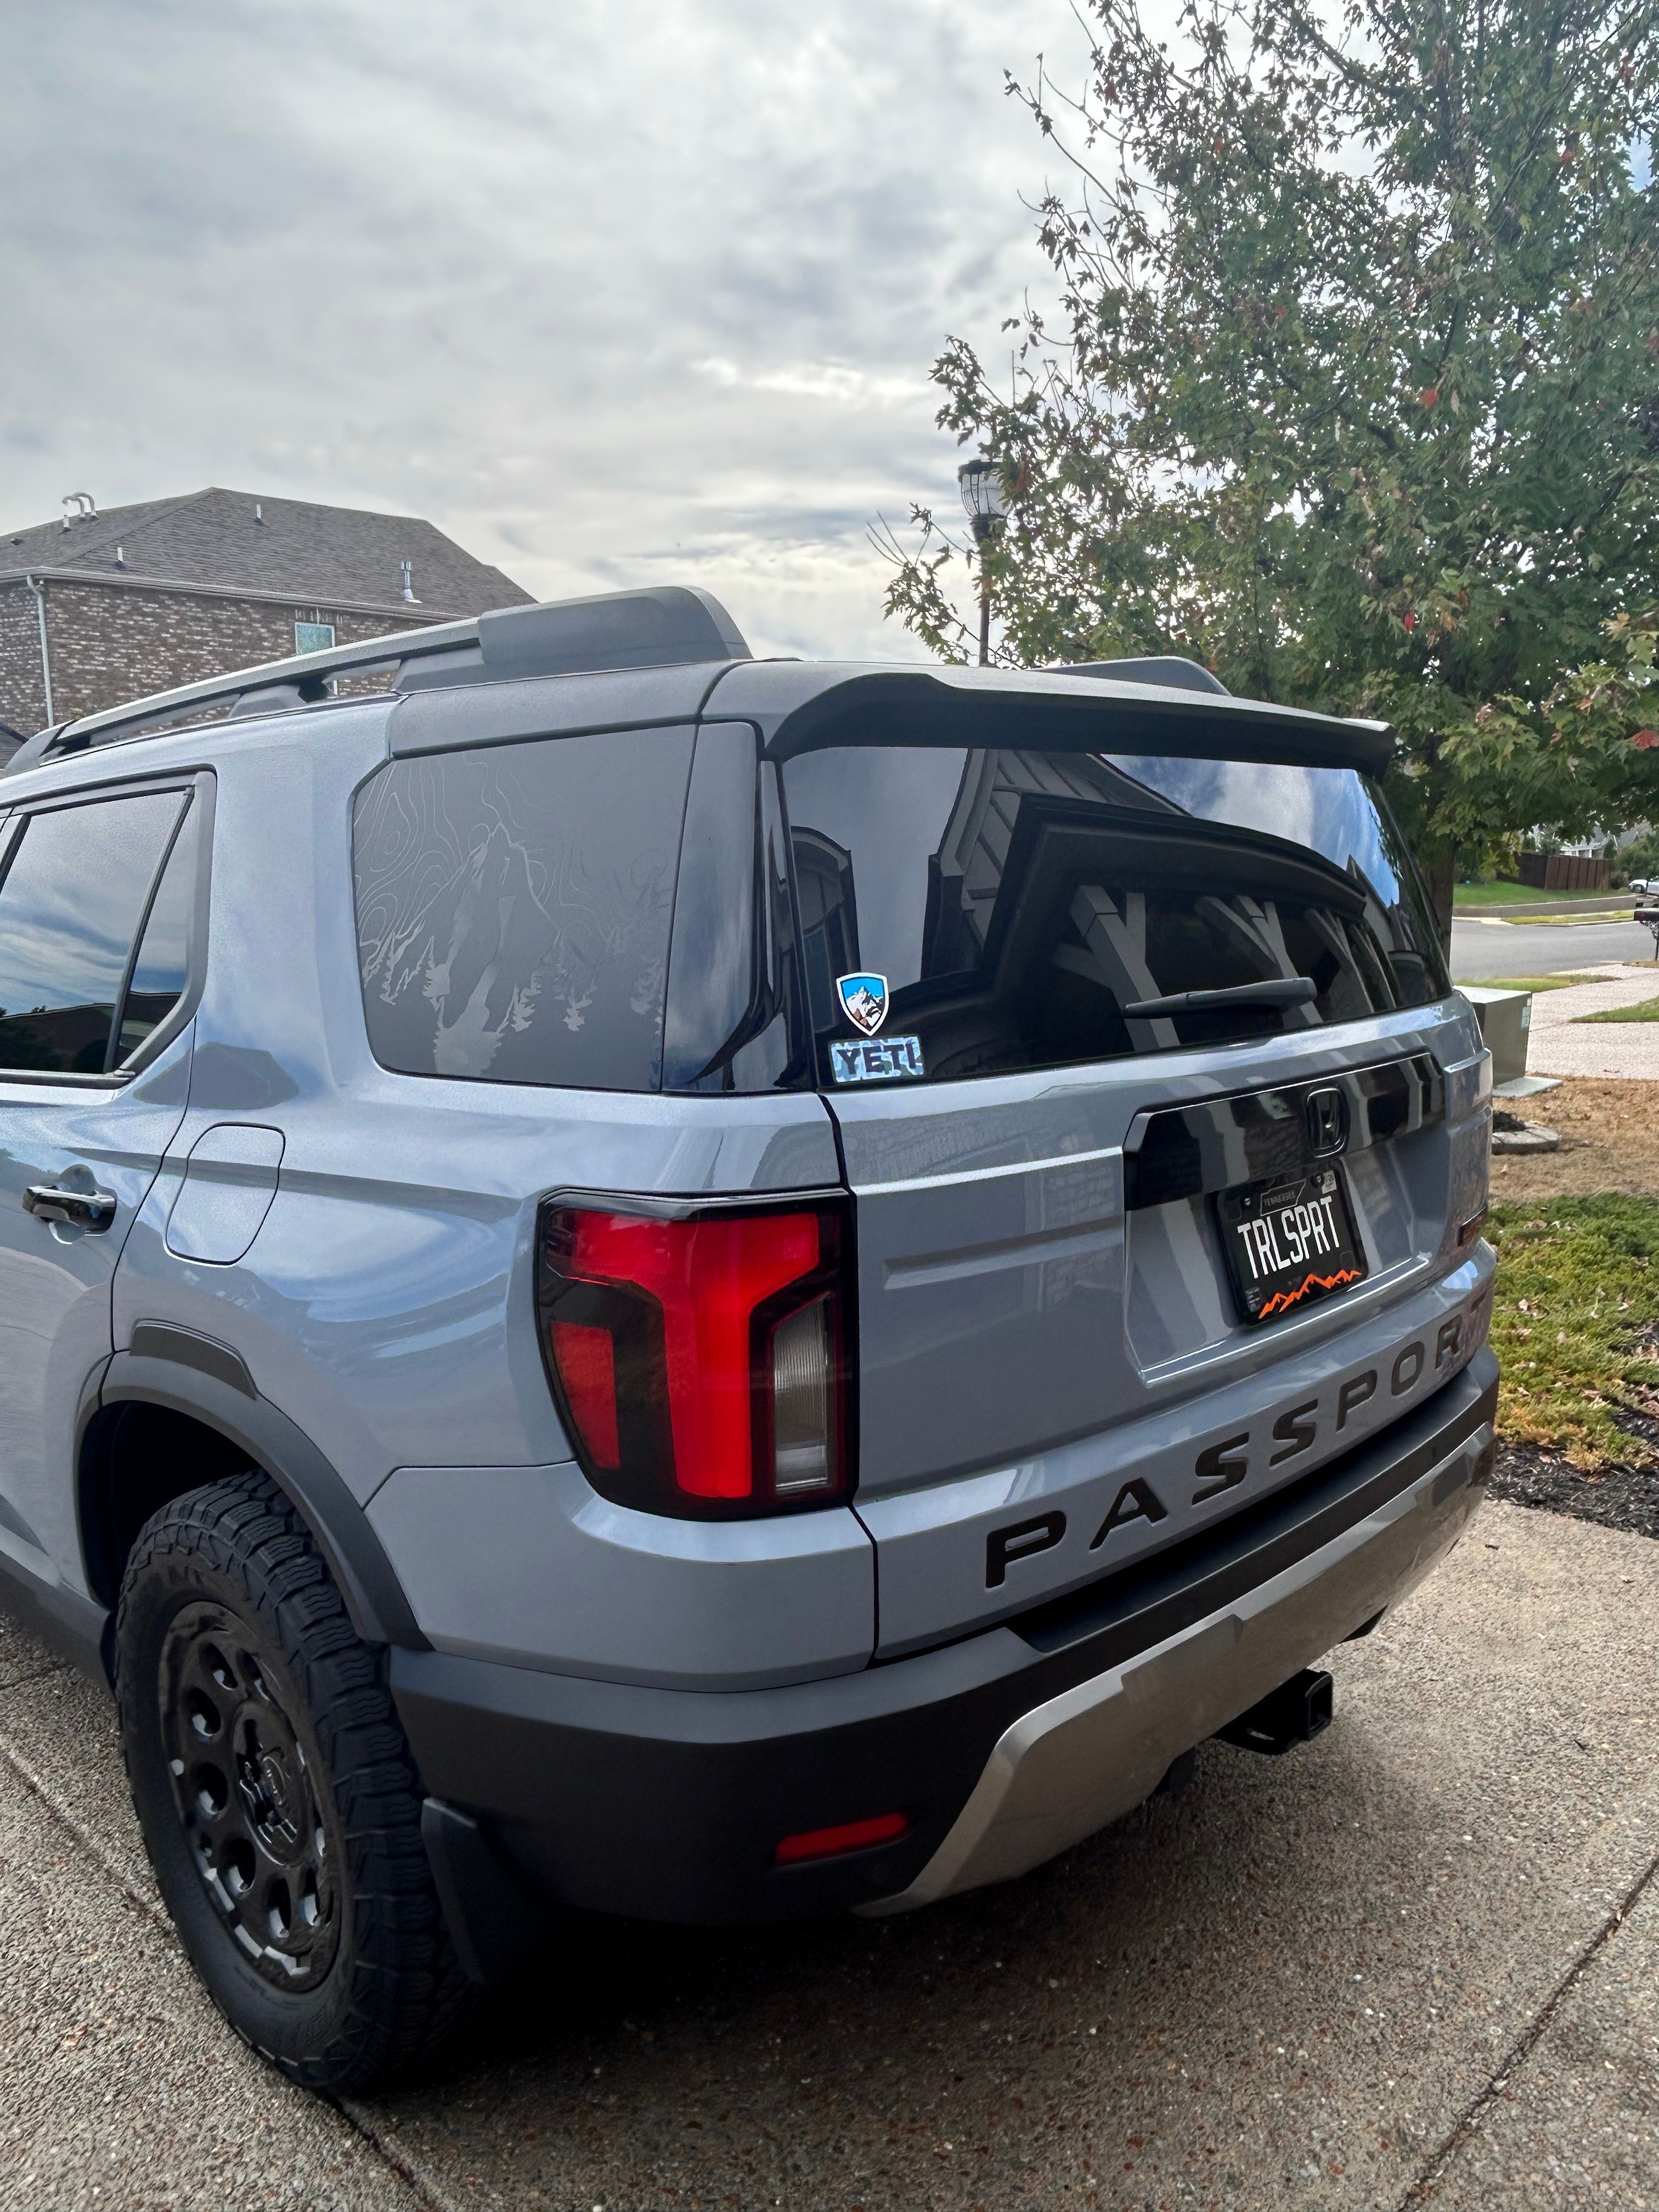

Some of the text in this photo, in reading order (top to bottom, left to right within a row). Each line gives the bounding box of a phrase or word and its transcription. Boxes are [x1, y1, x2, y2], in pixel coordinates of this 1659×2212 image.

[837, 1042, 916, 1075] YETI
[1237, 1195, 1340, 1279] TRLSPRT
[985, 1289, 1488, 1589] PASSPORT
